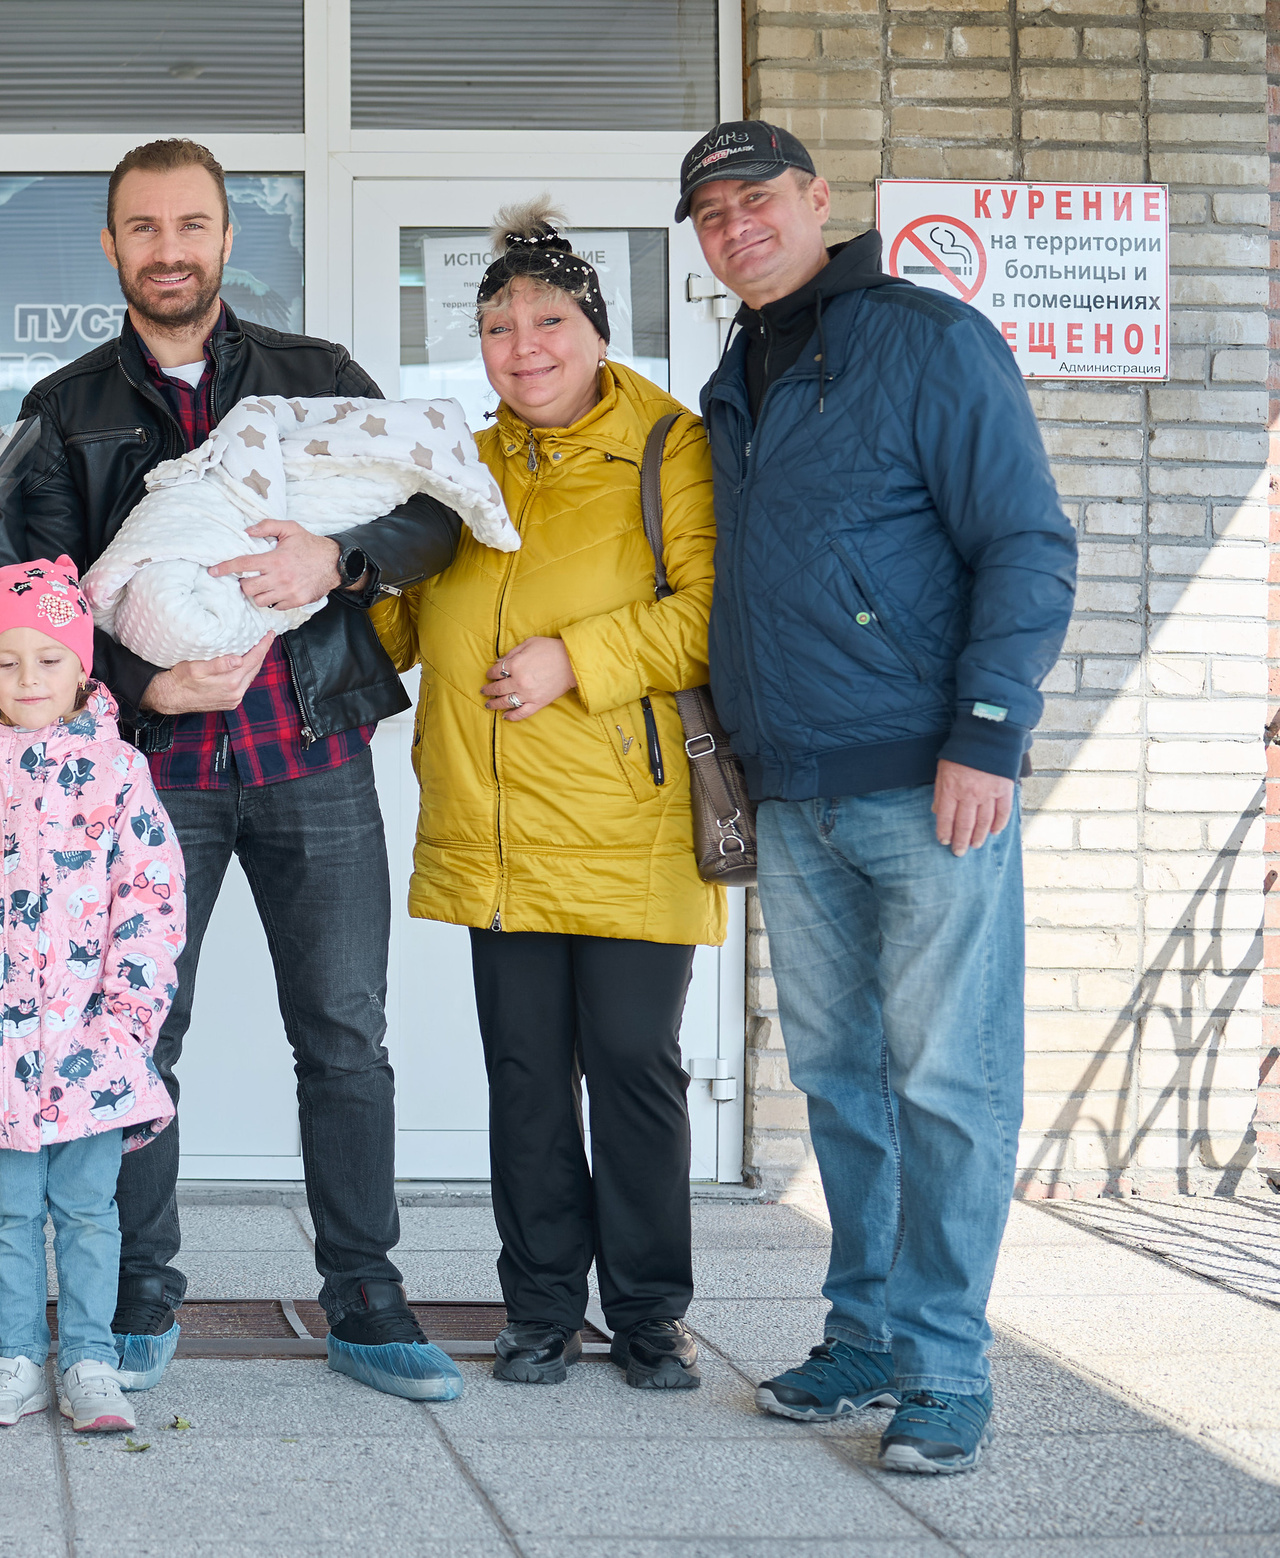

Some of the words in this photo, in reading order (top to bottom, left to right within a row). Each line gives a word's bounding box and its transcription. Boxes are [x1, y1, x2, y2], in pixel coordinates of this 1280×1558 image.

[729, 144, 755, 155] MARK
[974, 188, 1161, 222] КУРЕНИЕ
[990, 234, 1017, 250] на
[1024, 235, 1161, 256] территории
[1004, 259, 1126, 283] больницы
[1133, 265, 1147, 281] и
[992, 293, 1006, 308] в
[1013, 293, 1162, 312] помещениях
[1059, 361, 1162, 375] Администрация
